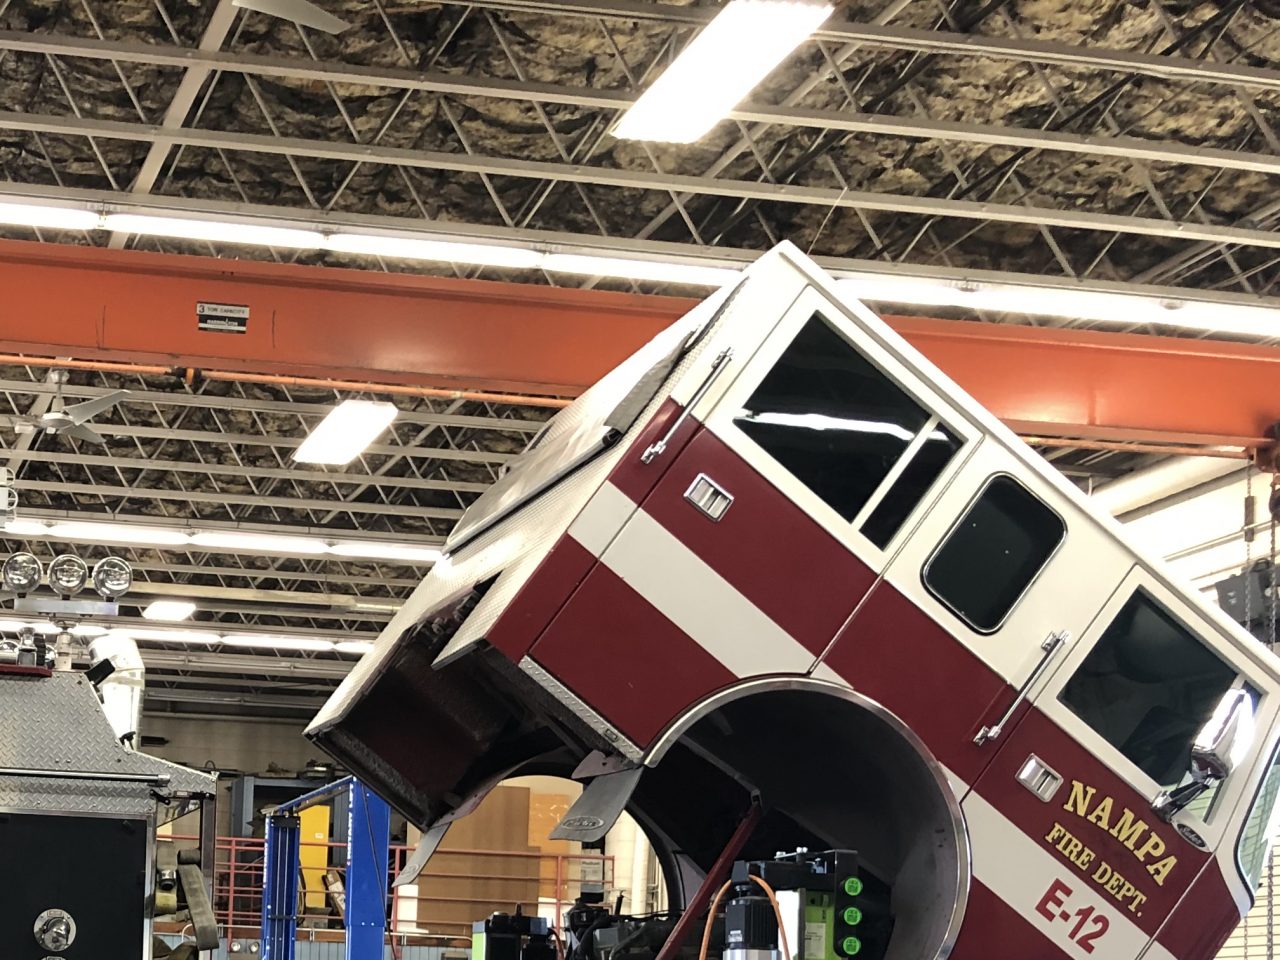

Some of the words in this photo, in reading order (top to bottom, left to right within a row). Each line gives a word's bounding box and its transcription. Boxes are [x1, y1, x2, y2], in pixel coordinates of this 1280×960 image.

[198, 304, 205, 313] 3
[1045, 822, 1096, 871] FIRE
[1091, 860, 1148, 917] DEPT.
[1063, 779, 1178, 886] NAMPA
[1034, 878, 1110, 955] E-12
